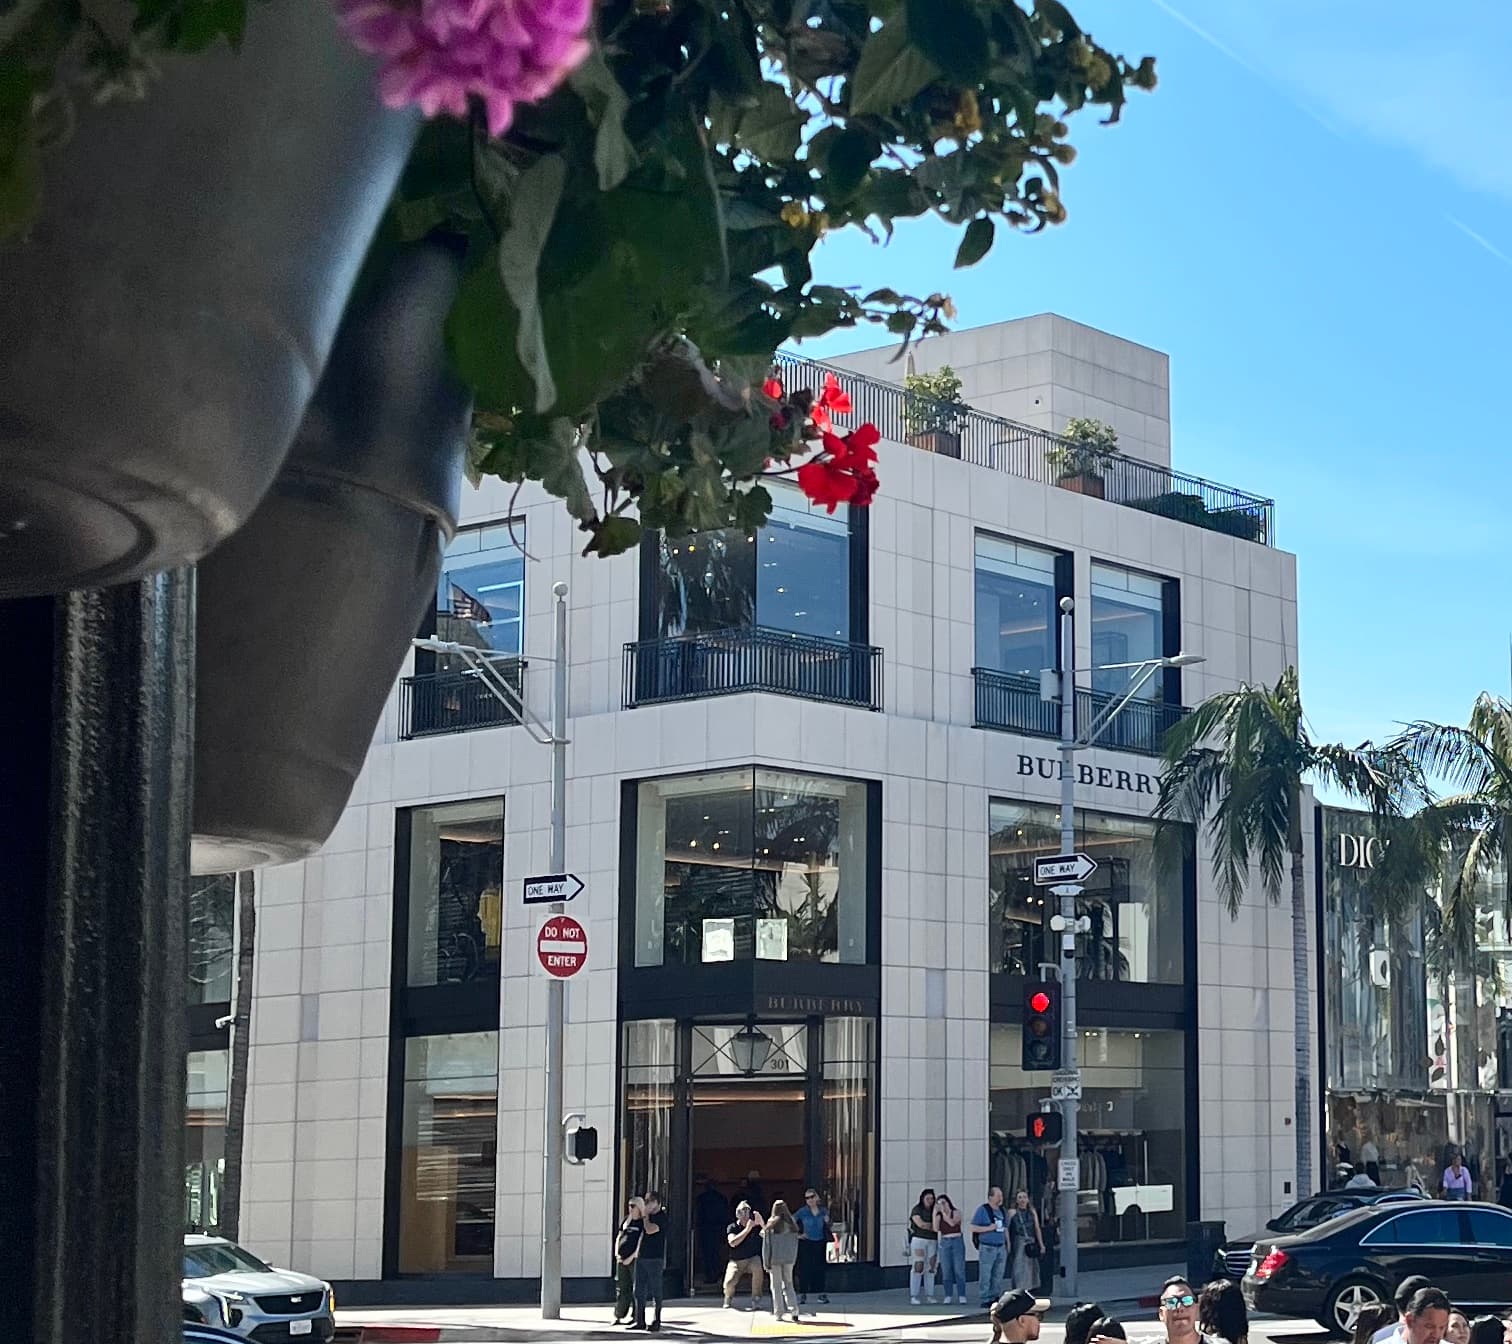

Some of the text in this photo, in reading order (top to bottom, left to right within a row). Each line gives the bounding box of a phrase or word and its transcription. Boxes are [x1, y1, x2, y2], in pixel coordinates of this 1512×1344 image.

[1340, 833, 1384, 870] DIO
[1040, 863, 1077, 876] ONE WAY
[527, 882, 565, 896] ONE WAY
[544, 926, 581, 939] DO NOT
[547, 955, 577, 967] ENTER
[770, 1059, 789, 1070] 301
[1052, 1086, 1064, 1097] OK
